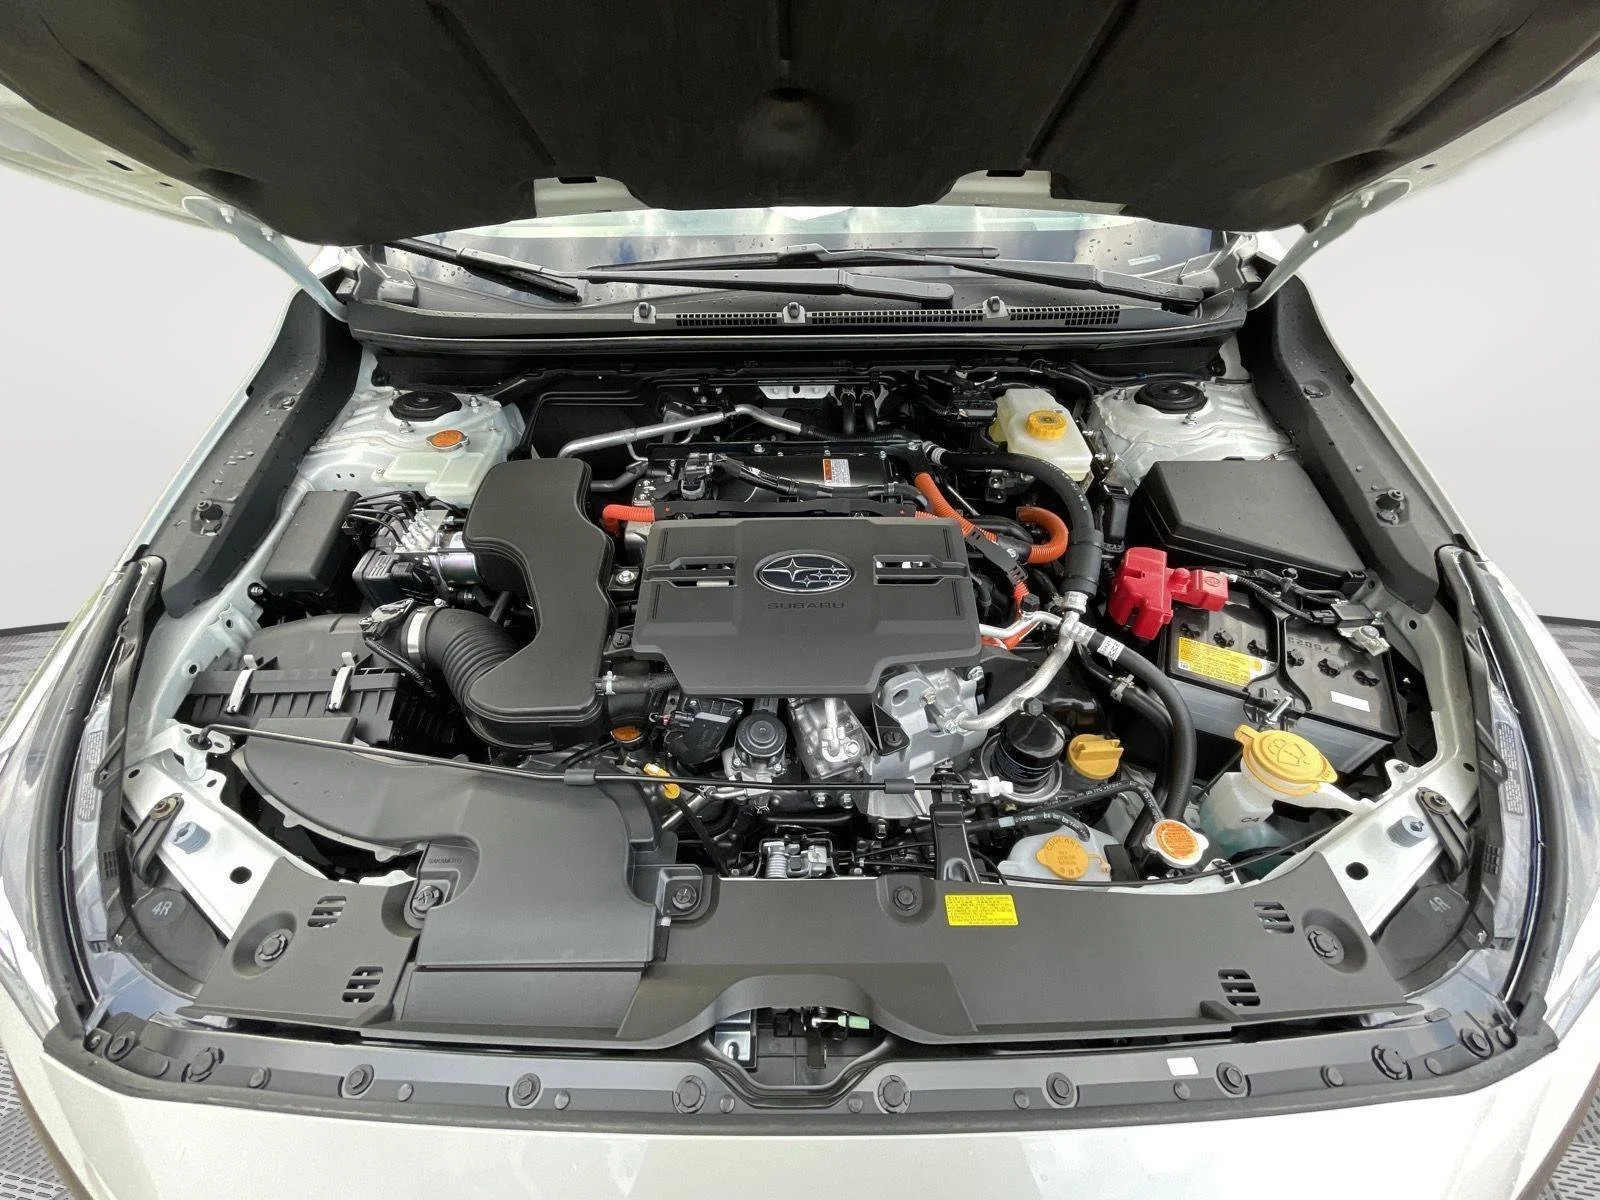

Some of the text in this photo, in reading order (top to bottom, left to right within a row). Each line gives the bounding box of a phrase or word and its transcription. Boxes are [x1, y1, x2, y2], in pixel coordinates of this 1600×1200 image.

[767, 601, 845, 610] SUBARU
[151, 901, 173, 916] 4R
[1428, 896, 1451, 913] 4R
